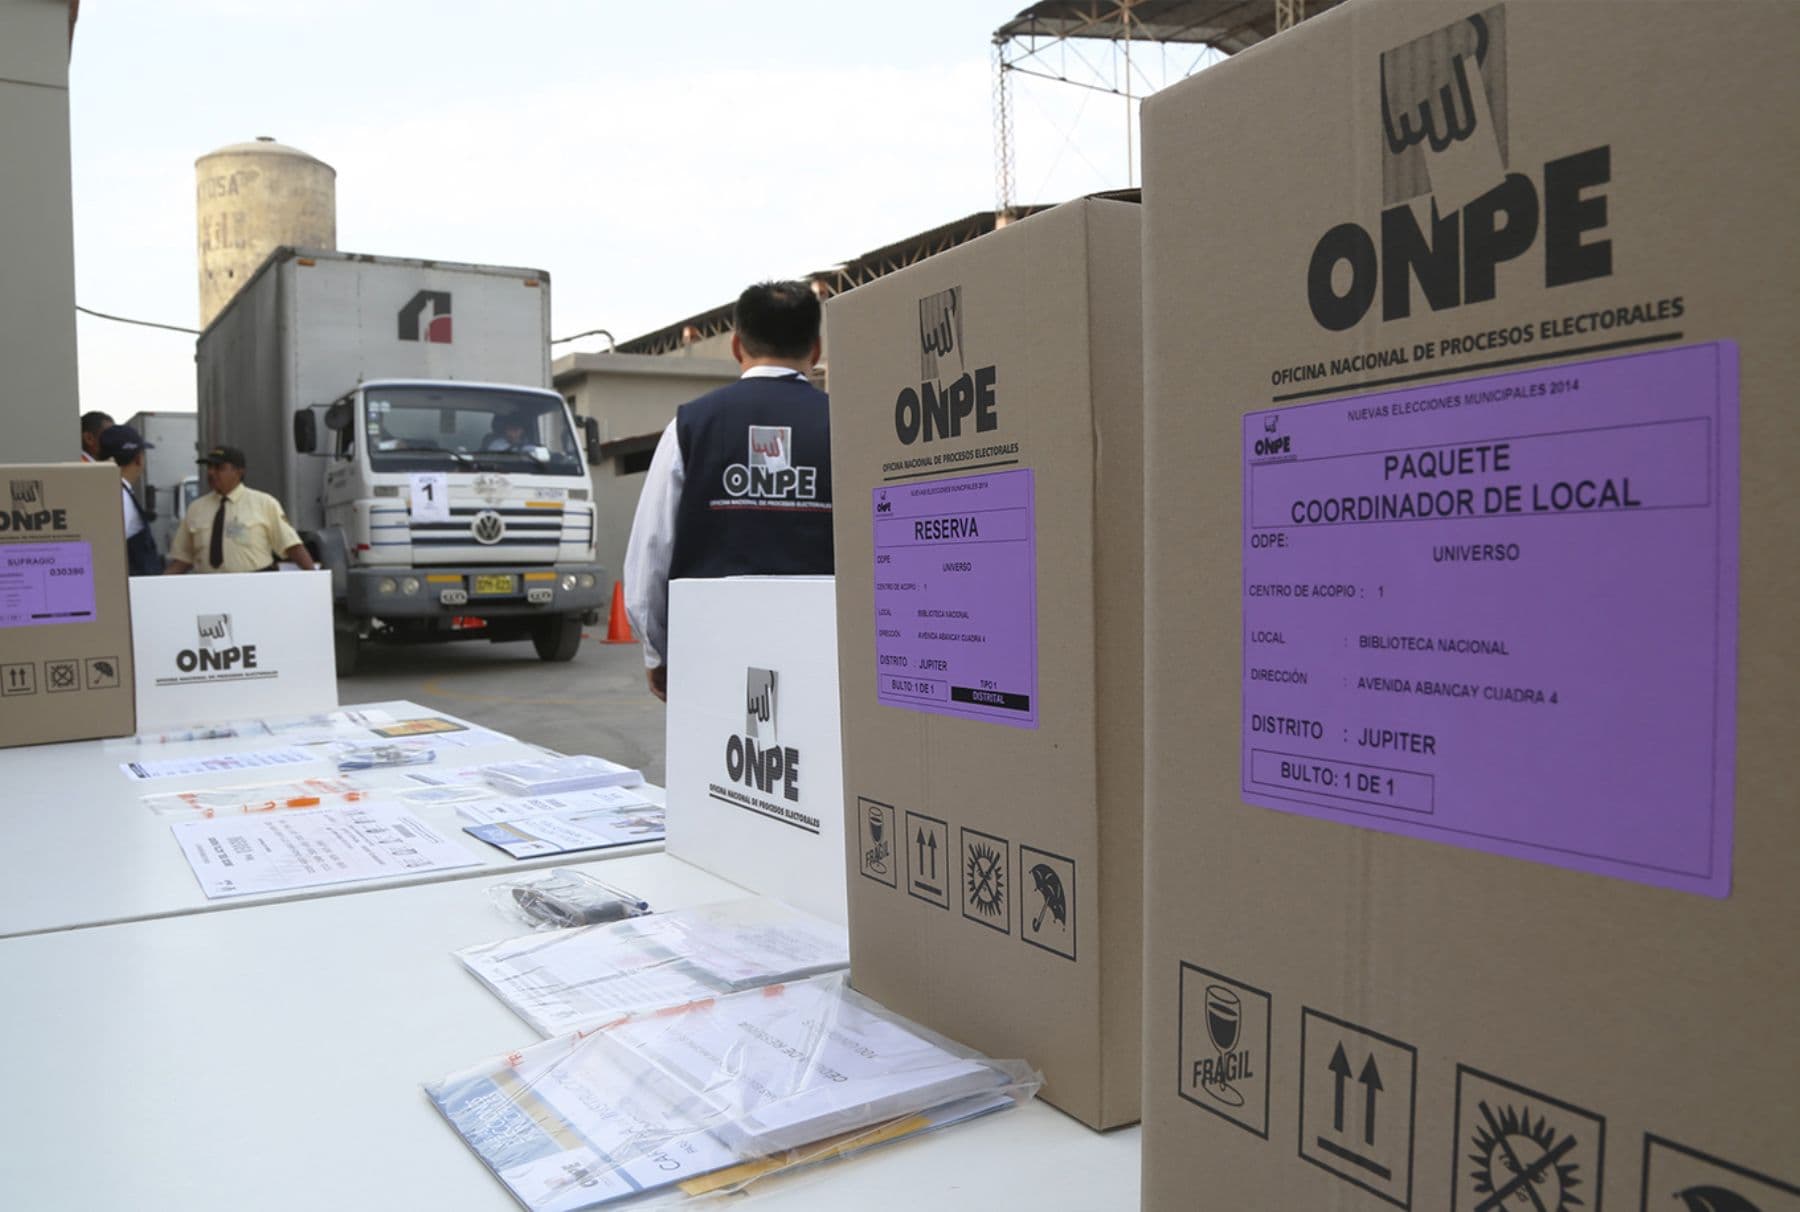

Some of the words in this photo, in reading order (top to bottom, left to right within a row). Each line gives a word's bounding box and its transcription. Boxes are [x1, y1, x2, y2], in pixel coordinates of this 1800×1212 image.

[1307, 144, 1613, 331] ONPE
[1271, 362, 1327, 386] OFICINA
[1330, 346, 1408, 376] NACIONAL
[1413, 342, 1436, 362] DE
[1440, 325, 1534, 357] PROCESOS
[1540, 297, 1685, 340] ELECTORALES
[895, 365, 998, 446] ONPE
[1348, 406, 1390, 422] NUEVAS
[1391, 396, 1462, 416] ELECCIONES
[1463, 382, 1547, 406] MUNICIPALES
[1550, 379, 1580, 395] 2014
[882, 461, 904, 473] OFICINA
[904, 458, 933, 469] NACIONAL
[934, 454, 942, 466] DE
[943, 449, 974, 464] PROCESOS
[975, 442, 1020, 459] ELECTORALES
[1254, 435, 1291, 456] ONPE
[1383, 443, 1511, 481] PAQUETE
[421, 483, 434, 502] 1
[722, 463, 817, 499] ONPE
[877, 501, 892, 513] ONPE
[1291, 487, 1474, 525] COORDINADOR
[1485, 486, 1523, 514] DE
[1533, 477, 1641, 511] LOCAL
[914, 516, 979, 541] RESERVA
[1251, 533, 1289, 549] ODPE:
[1432, 542, 1521, 563] UNIVERSO
[942, 561, 972, 573] UNIVERSO
[1249, 584, 1292, 598] CENTRO
[1294, 584, 1309, 598] DE
[1311, 584, 1356, 598] ACOPIO
[1377, 585, 1384, 598] 1
[1251, 631, 1286, 645] LOCAL
[1359, 634, 1435, 652] BIBLIOTECA
[1437, 638, 1510, 656] NACIONAL
[175, 644, 258, 673] ONPE
[880, 654, 908, 668] DISTRITO
[919, 658, 949, 672] JUPITER
[919, 683, 930, 694] DE
[980, 679, 993, 690] TIPO
[1251, 667, 1308, 685] DIRECCIÓN
[972, 690, 1006, 706] DISTRITAL
[1357, 676, 1412, 694] AVENIDA
[1415, 679, 1481, 699] ABANCAY
[1483, 686, 1546, 705] CUADRA
[1548, 691, 1559, 705] 4
[1251, 713, 1324, 740] DISTRITO
[1357, 727, 1437, 755] JUPITER
[725, 733, 800, 803] ONPE
[1280, 760, 1339, 787] BULTO:
[1344, 771, 1351, 789] 1
[1357, 773, 1381, 795] DE
[1386, 778, 1395, 796] 1
[709, 783, 728, 796] OFICINA
[727, 789, 751, 805] NACIONAL
[751, 796, 759, 808] DE
[759, 799, 785, 816] PROCESOS
[785, 808, 820, 829] ELECTORALES
